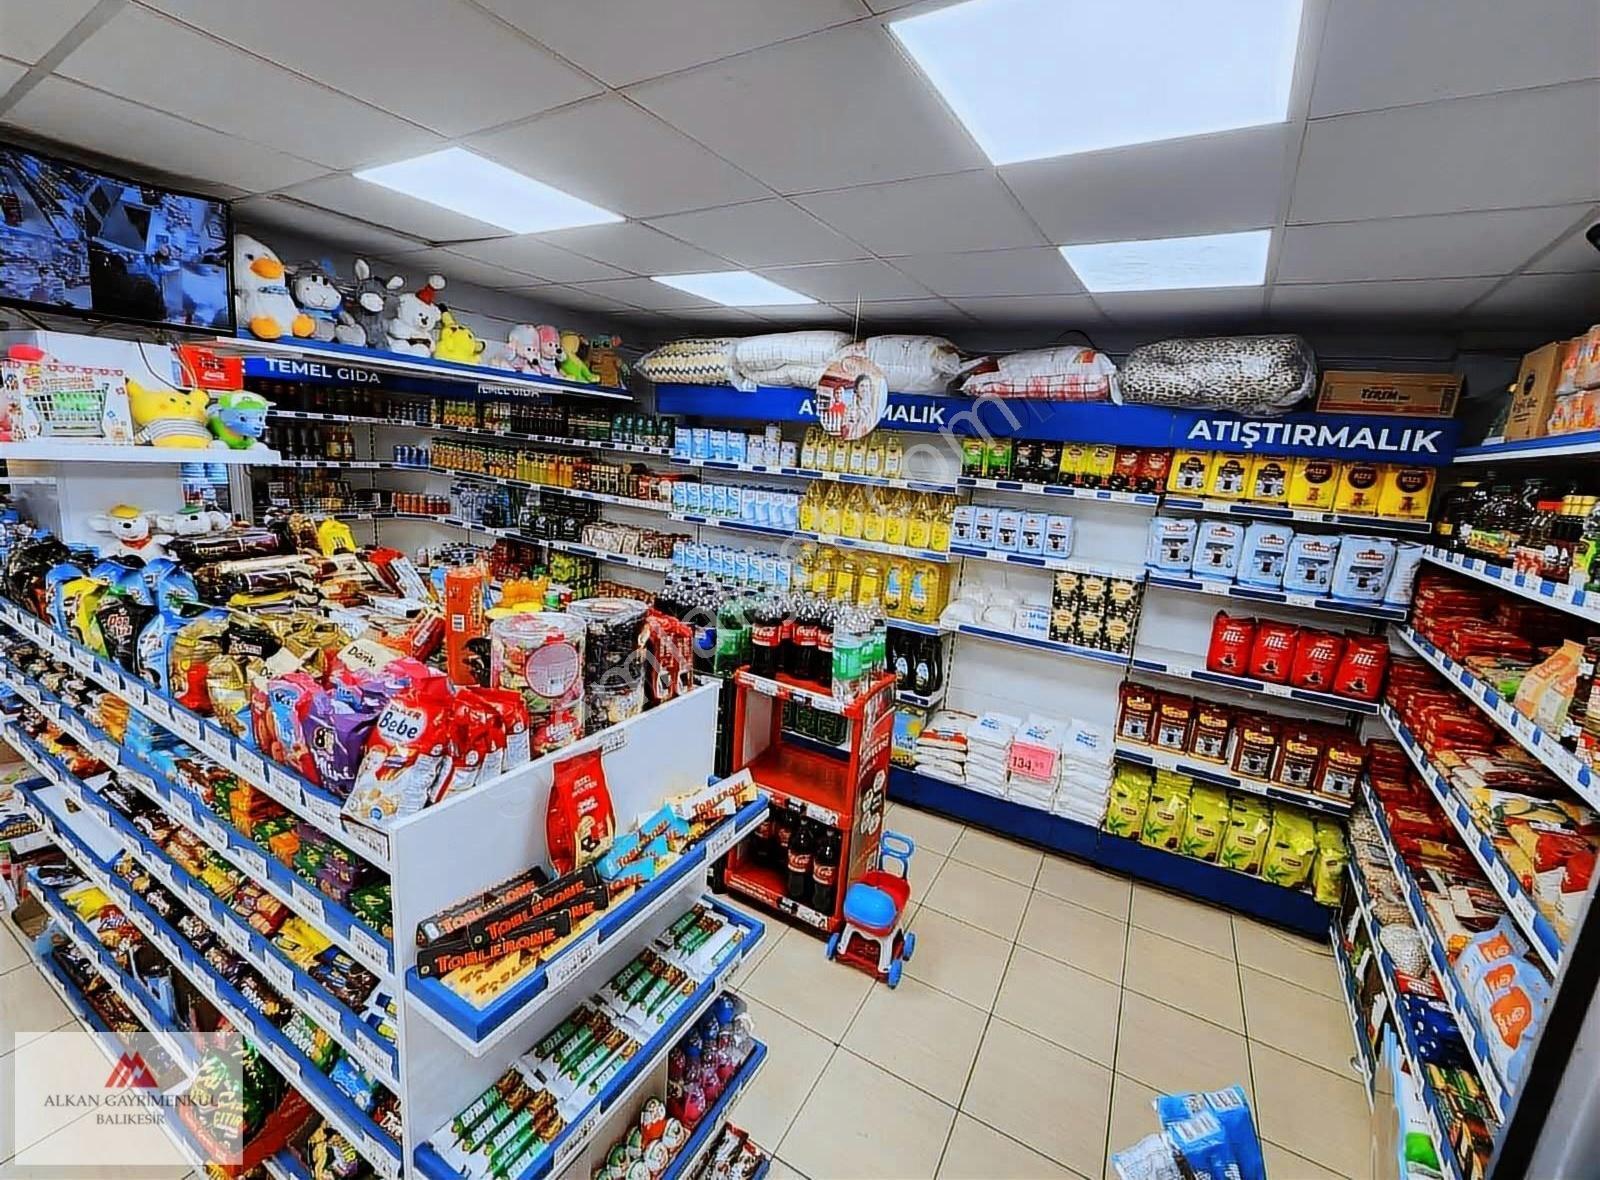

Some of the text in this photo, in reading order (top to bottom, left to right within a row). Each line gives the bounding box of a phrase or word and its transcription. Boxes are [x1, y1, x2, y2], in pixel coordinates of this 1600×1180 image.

[264, 357, 382, 385] TEMEL GIDA
[1187, 418, 1443, 453] ATIŞTIRMALIK
[379, 711, 418, 739] Bebe
[691, 780, 746, 816] TOBLERONE
[485, 879, 587, 940] TOBLERONE
[434, 927, 557, 973] TOBLERONE
